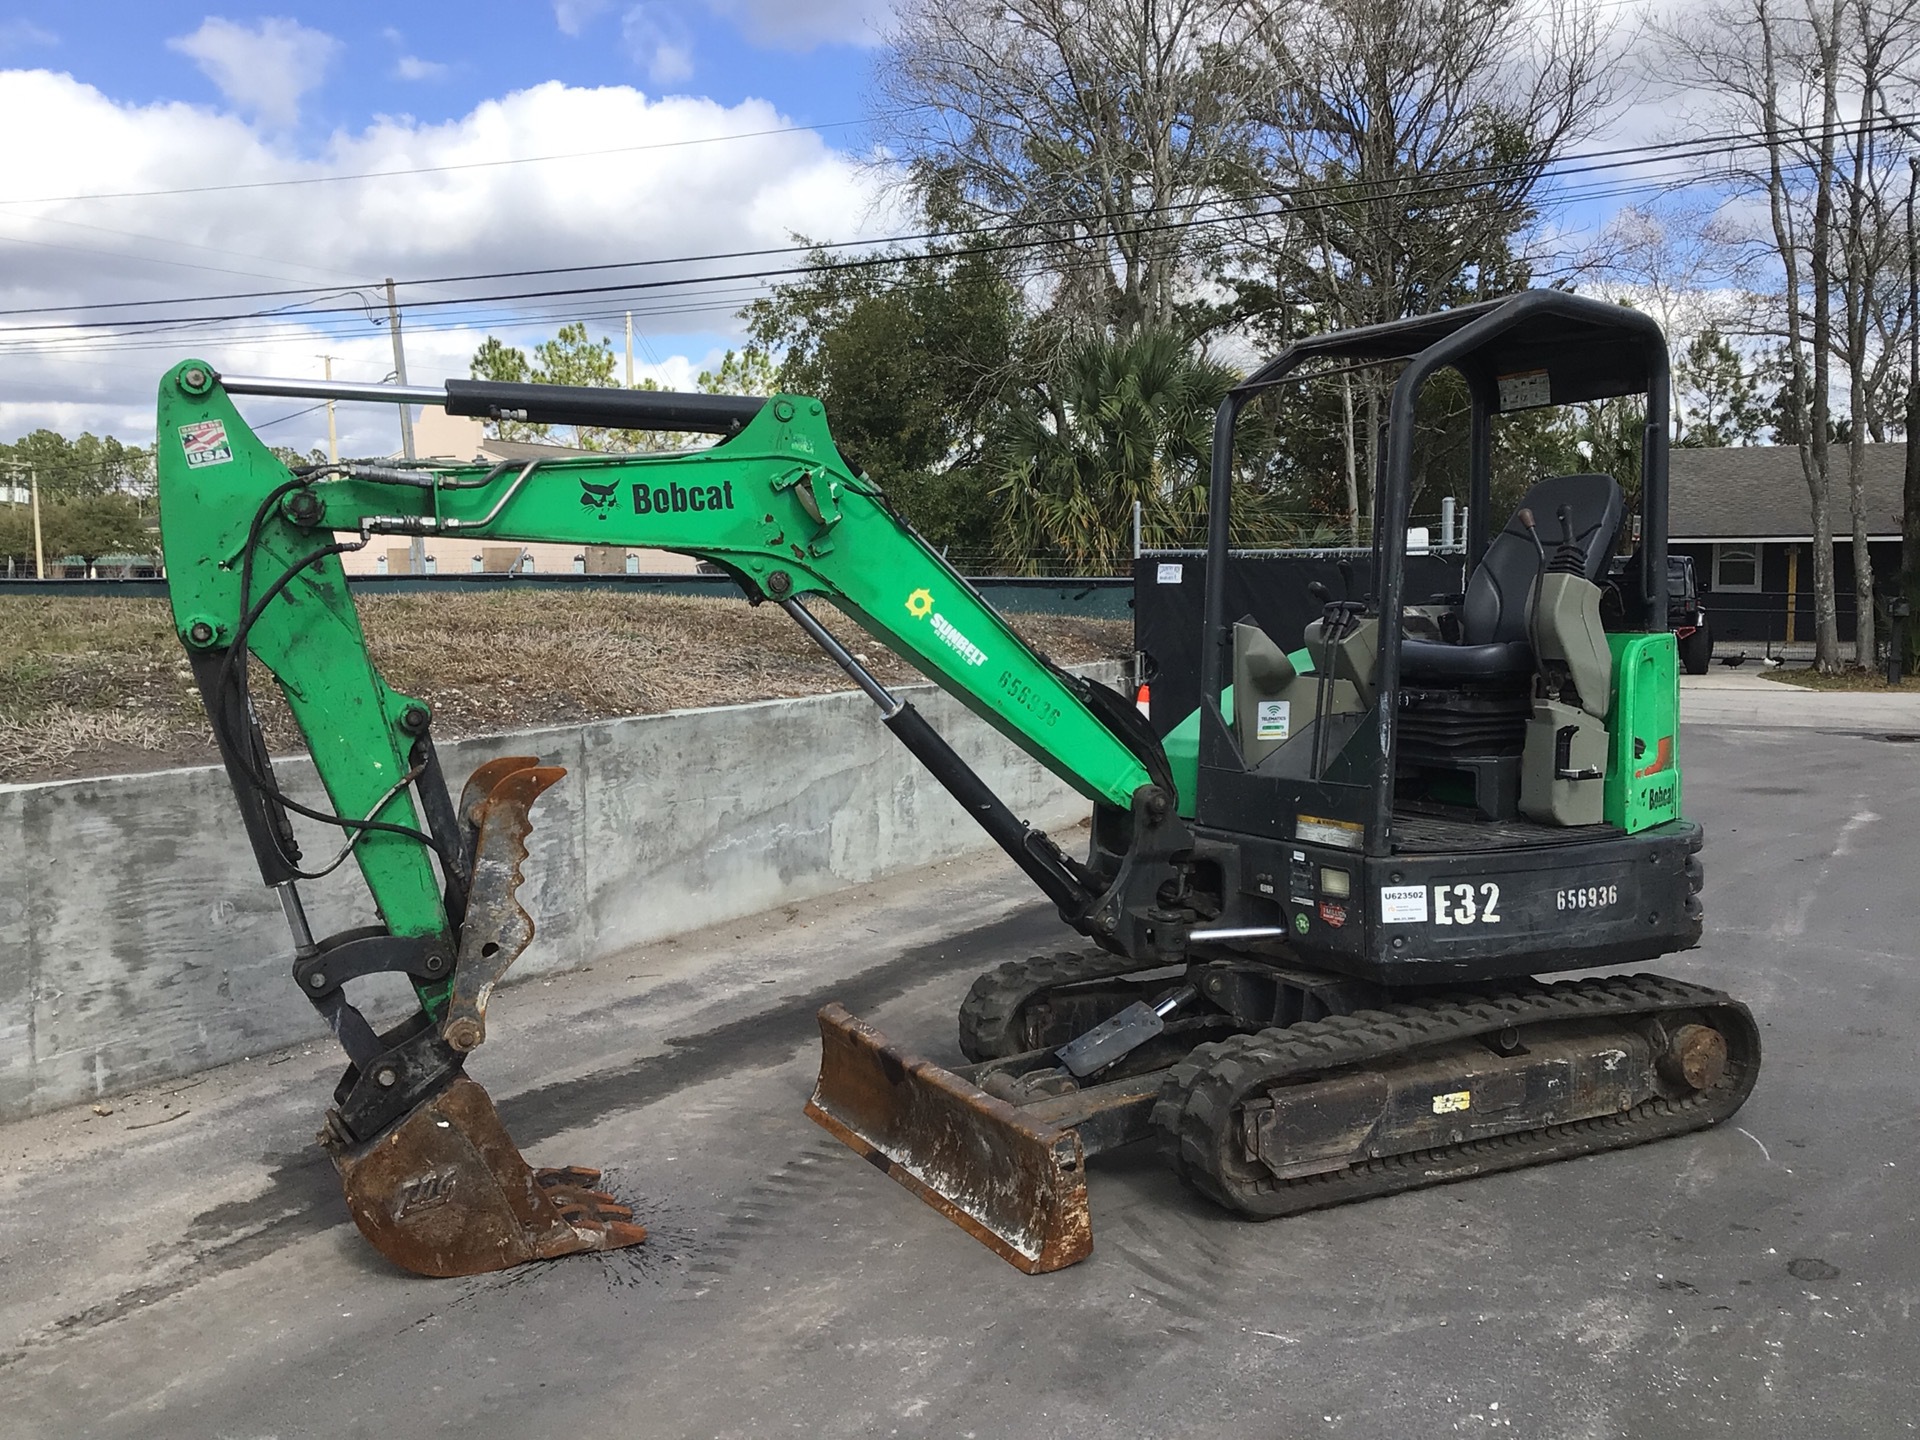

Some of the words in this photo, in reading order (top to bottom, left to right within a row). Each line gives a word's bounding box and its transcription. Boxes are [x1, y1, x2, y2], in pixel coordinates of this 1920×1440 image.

[188, 449, 229, 464] USA
[632, 481, 734, 514] Bobcat
[930, 613, 988, 666] SUNBELT
[934, 629, 973, 666] RENTALS
[1000, 671, 1061, 727] 656936
[1385, 891, 1424, 900] U623502
[1434, 882, 1501, 925] E32
[1557, 885, 1617, 910] 656936
